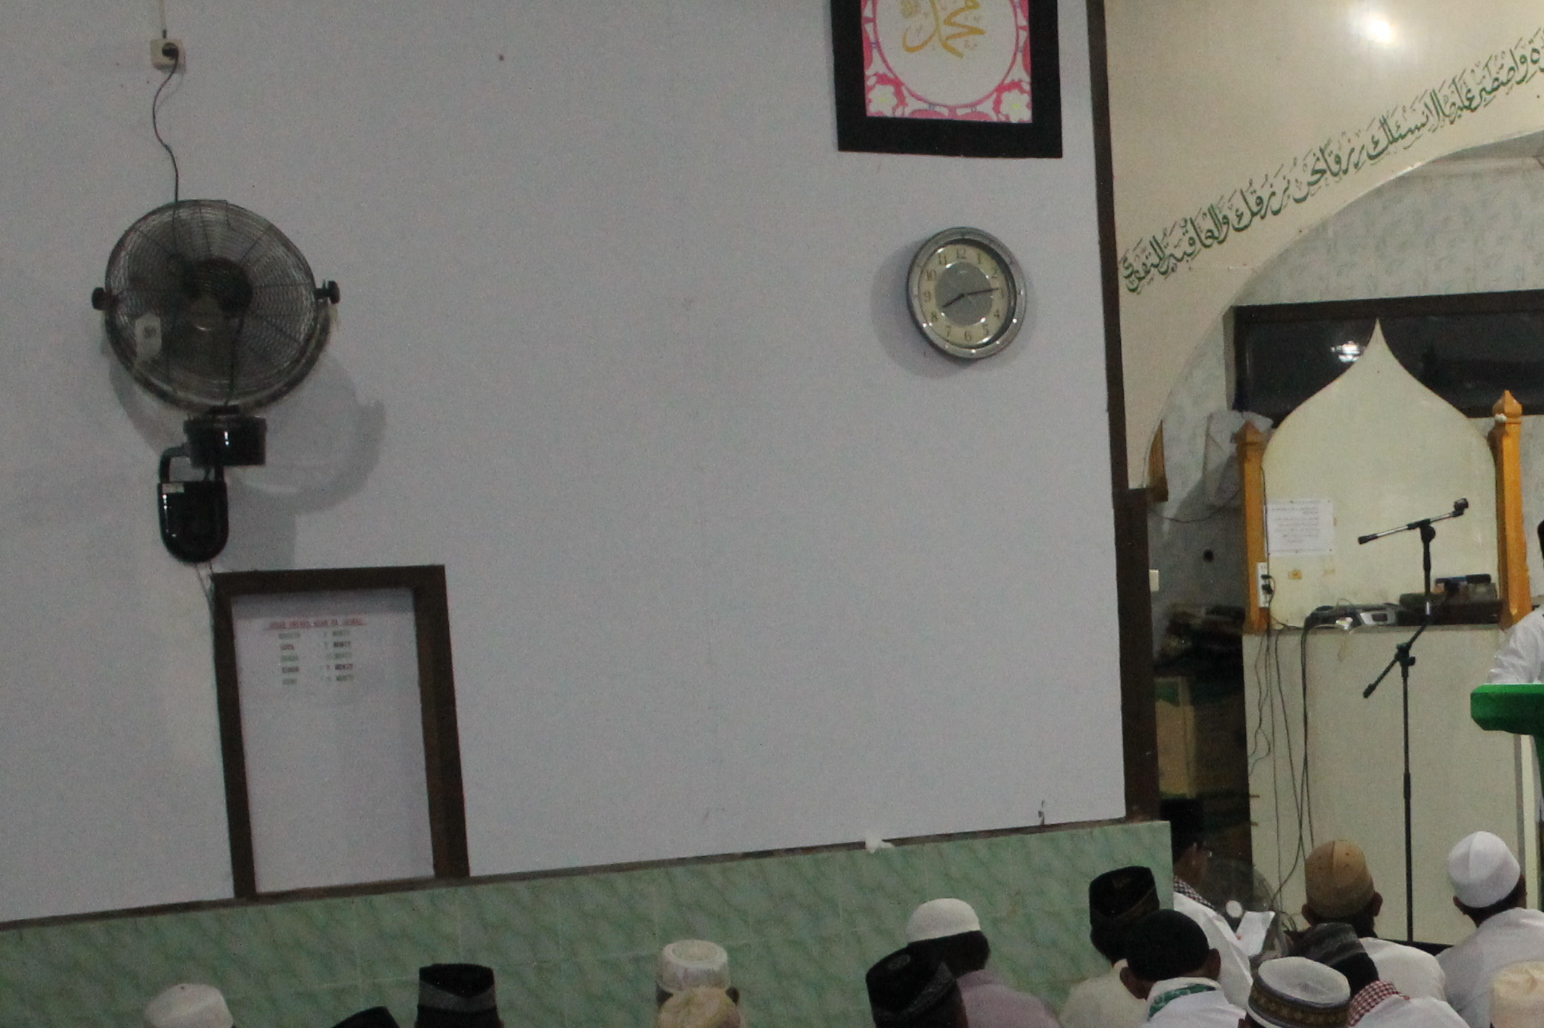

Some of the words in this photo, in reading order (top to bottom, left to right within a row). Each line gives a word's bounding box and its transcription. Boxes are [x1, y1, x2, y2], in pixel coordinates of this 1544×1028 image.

[956, 248, 967, 259] 12
[923, 291, 931, 302] 9
[964, 330, 972, 342] 6
